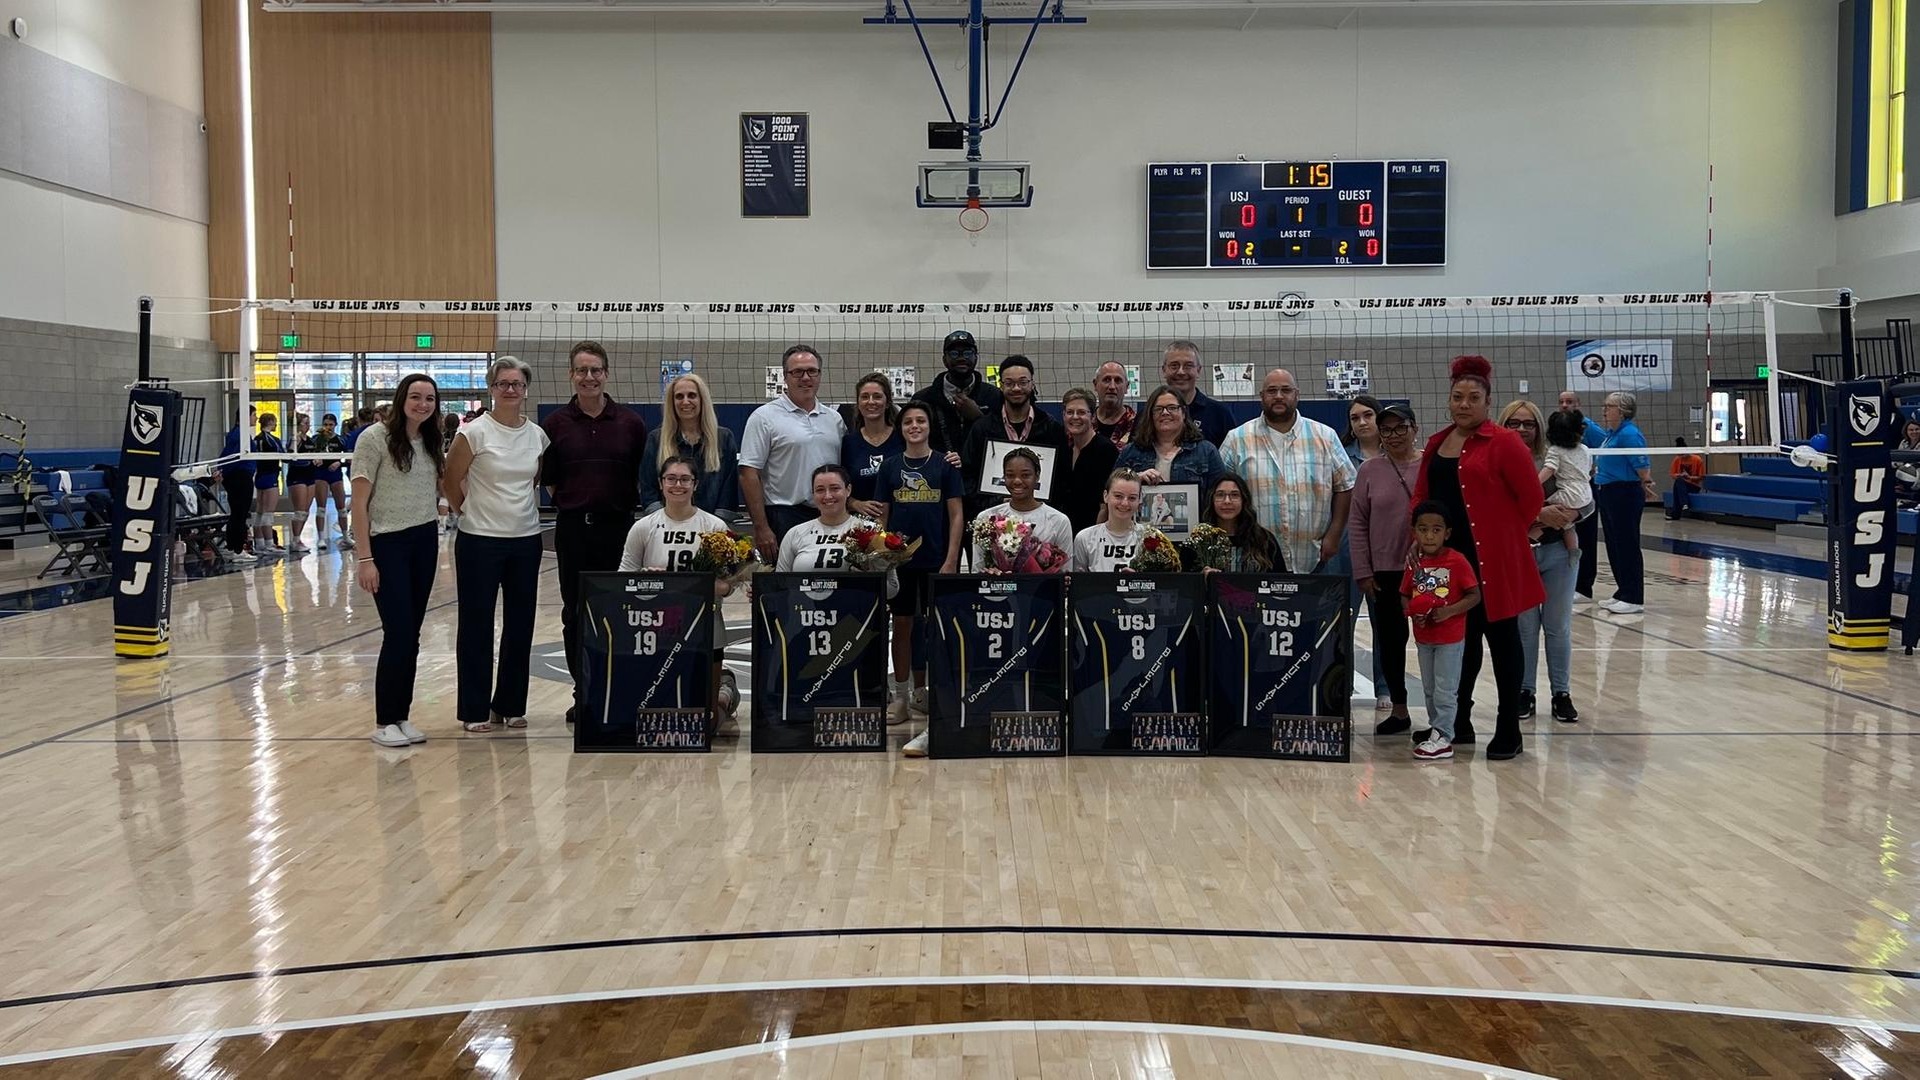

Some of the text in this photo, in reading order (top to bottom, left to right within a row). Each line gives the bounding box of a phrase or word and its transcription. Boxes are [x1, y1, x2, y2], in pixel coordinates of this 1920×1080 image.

[772, 116, 792, 124] 1000
[772, 124, 800, 132] POINT
[772, 133, 796, 141] CLUB
[1154, 168, 1202, 176] PLYR FLS PTS
[1289, 164, 1329, 186] 1:15
[1392, 165, 1440, 173] PLYR FLS PTS
[1230, 191, 1249, 202] USJ
[1338, 190, 1372, 201] GUEST
[1241, 204, 1256, 227] 0
[1297, 207, 1303, 223] 1
[1359, 203, 1374, 226] 0
[1219, 231, 1236, 239] WON
[1298, 230, 1311, 238] SET
[1227, 239, 1238, 258] 0
[1245, 242, 1254, 256] 2
[1339, 241, 1348, 255] 2
[1367, 238, 1378, 256] 0
[312, 300, 400, 311] USJ BLUE JAYS
[1227, 299, 1315, 311] USJ BLUE JAYS
[1359, 297, 1447, 309] USJ BLUE JAYS
[1491, 295, 1579, 306] USJ BLUE JAYS
[1623, 294, 1646, 304] USJ
[1648, 294, 1680, 304] BLUE
[444, 301, 533, 312] USJ BLUE JAYS
[577, 302, 665, 313] USJ BLUE JAYS
[708, 303, 796, 313] USJ BLUE JAYS
[839, 303, 925, 314] USJ BLUE JAYS
[968, 302, 1054, 314] USJ BLUE JAYS
[1097, 301, 1184, 312] USJ BLUE JAYS
[417, 336, 432, 348] EXIT
[1611, 355, 1658, 368] UNITED
[1854, 468, 1885, 588] USJ
[120, 476, 159, 595] USJ
[663, 531, 697, 544] USJ
[816, 534, 841, 545] US
[1104, 544, 1136, 558] USJ
[666, 550, 693, 571] 19
[814, 548, 843, 569] 13
[628, 610, 664, 626] USJ
[800, 610, 837, 626] USJ
[976, 612, 1015, 628] USJ
[1117, 614, 1155, 631] USJ
[1262, 610, 1301, 627] USJ
[634, 631, 657, 655] 19
[808, 630, 831, 656] 13
[988, 633, 1002, 658] 2
[1131, 635, 1145, 660] 8
[1269, 631, 1293, 656] 12
